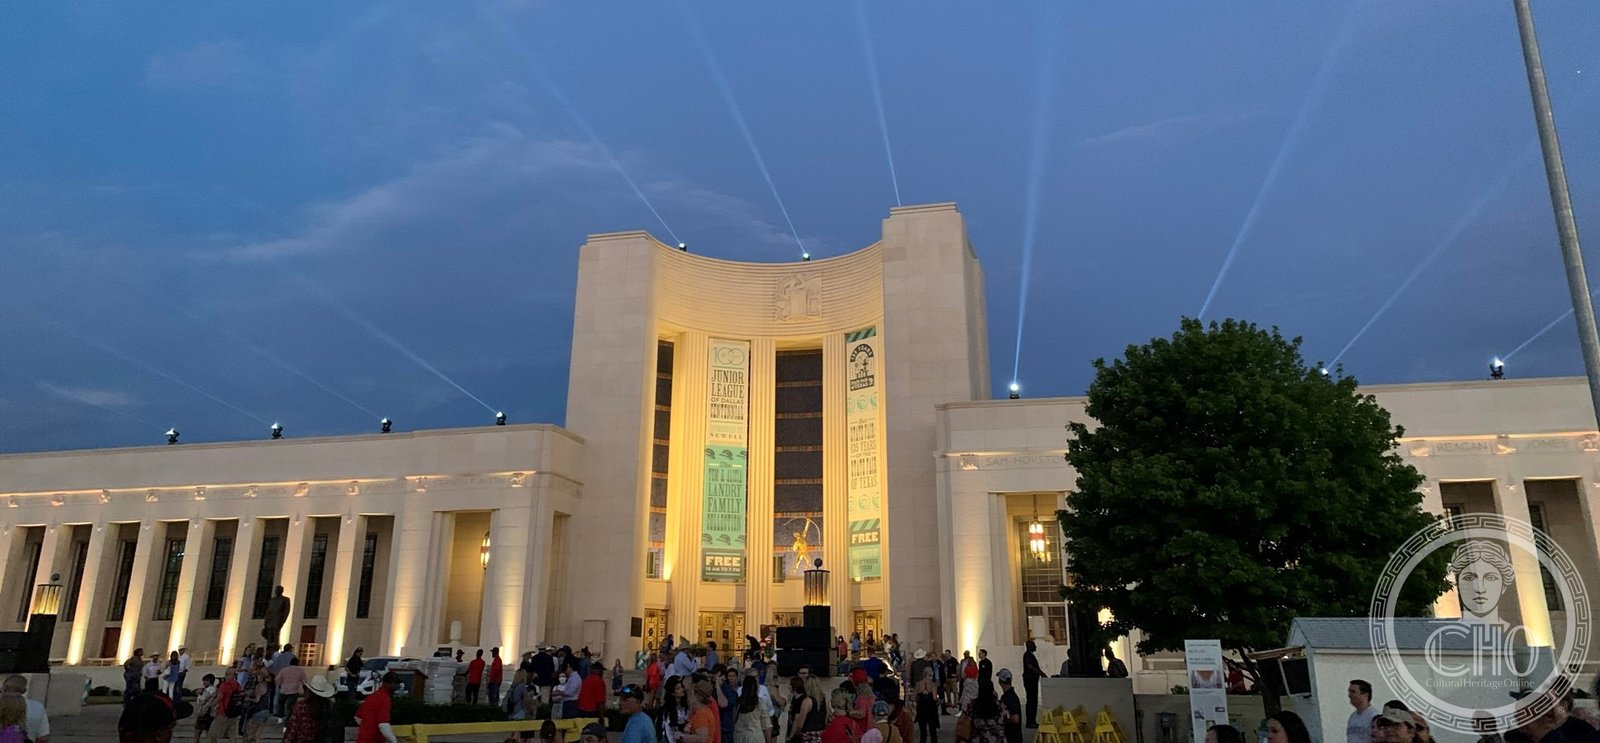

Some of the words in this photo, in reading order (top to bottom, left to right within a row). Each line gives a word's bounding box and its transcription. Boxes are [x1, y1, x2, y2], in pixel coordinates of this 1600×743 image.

[711, 346, 745, 366] 100
[711, 369, 744, 384] JUNIOR
[711, 383, 744, 398] LEAGUE
[1436, 441, 1488, 452] REAGAN
[1527, 438, 1569, 449] JONES
[986, 456, 1009, 466] SAM
[708, 468, 719, 482] TOM
[859, 475, 878, 489] TEXAS
[708, 482, 742, 497] LANDRY
[707, 497, 742, 513] FAMILY
[852, 532, 878, 544] FREE
[705, 556, 741, 567] FREE
